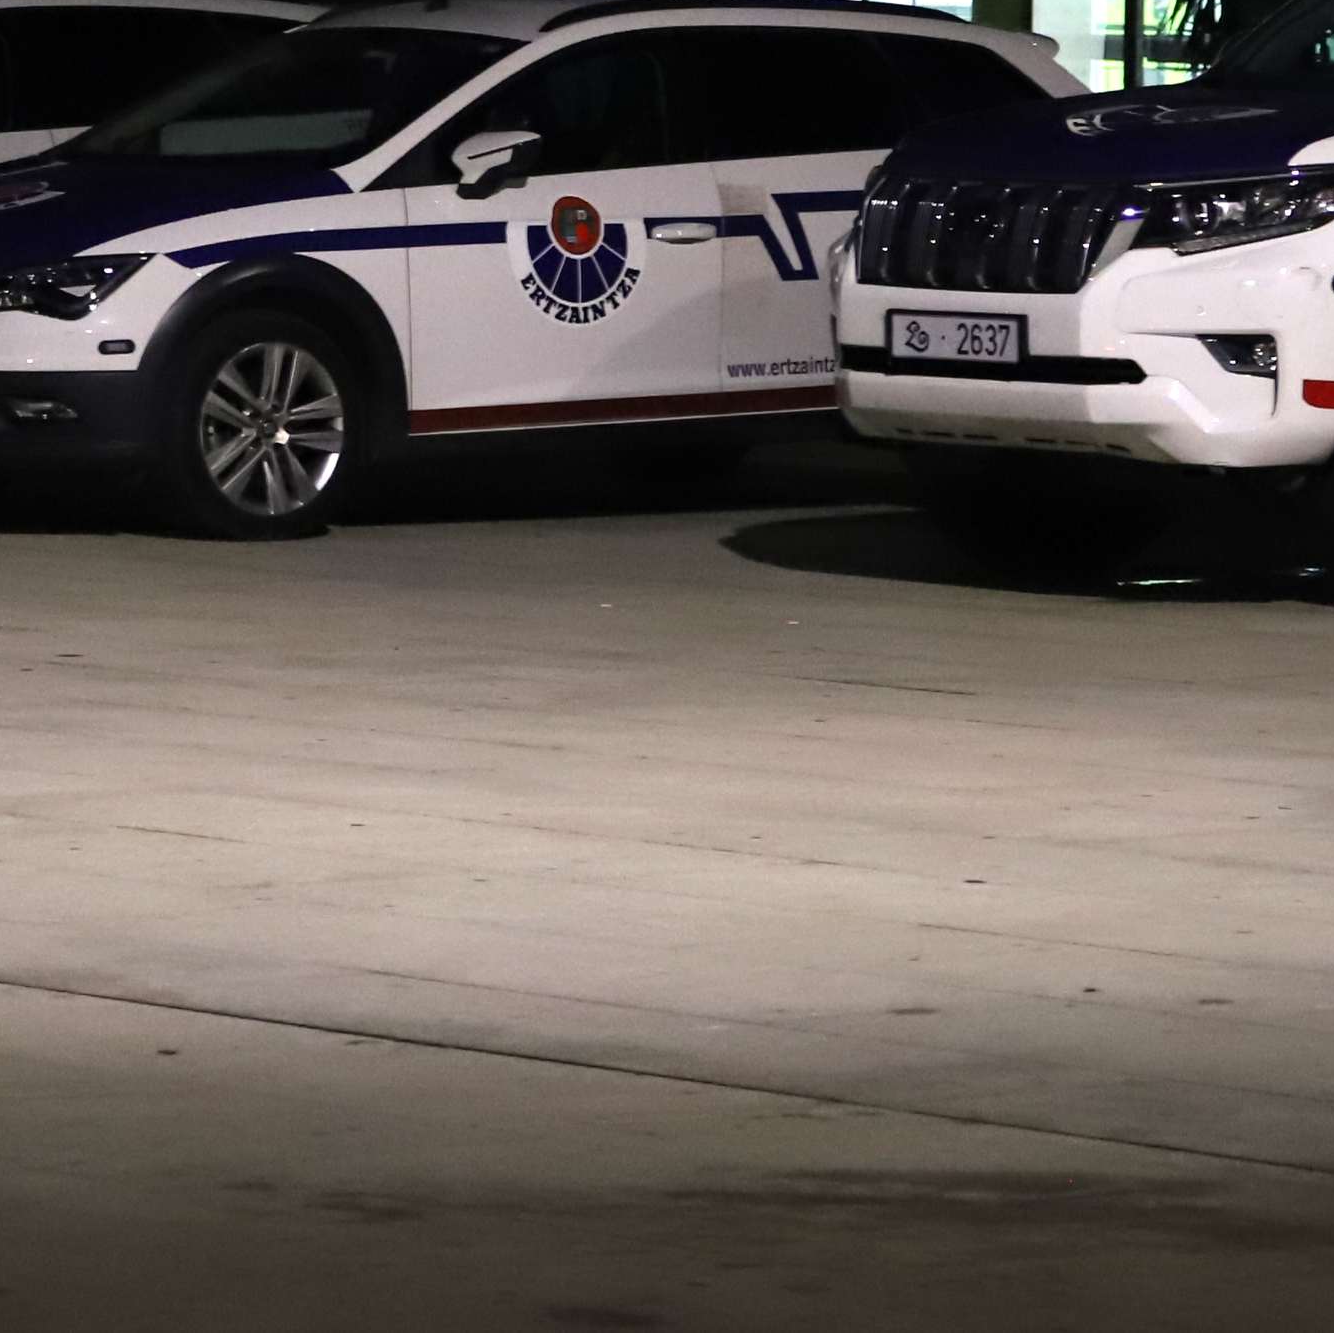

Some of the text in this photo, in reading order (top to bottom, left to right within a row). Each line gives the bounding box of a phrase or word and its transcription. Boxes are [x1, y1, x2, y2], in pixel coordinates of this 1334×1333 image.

[519, 266, 641, 325] ERTZAINTZA
[956, 322, 1011, 358] 2637
[726, 356, 837, 378] www.ertzaintz
